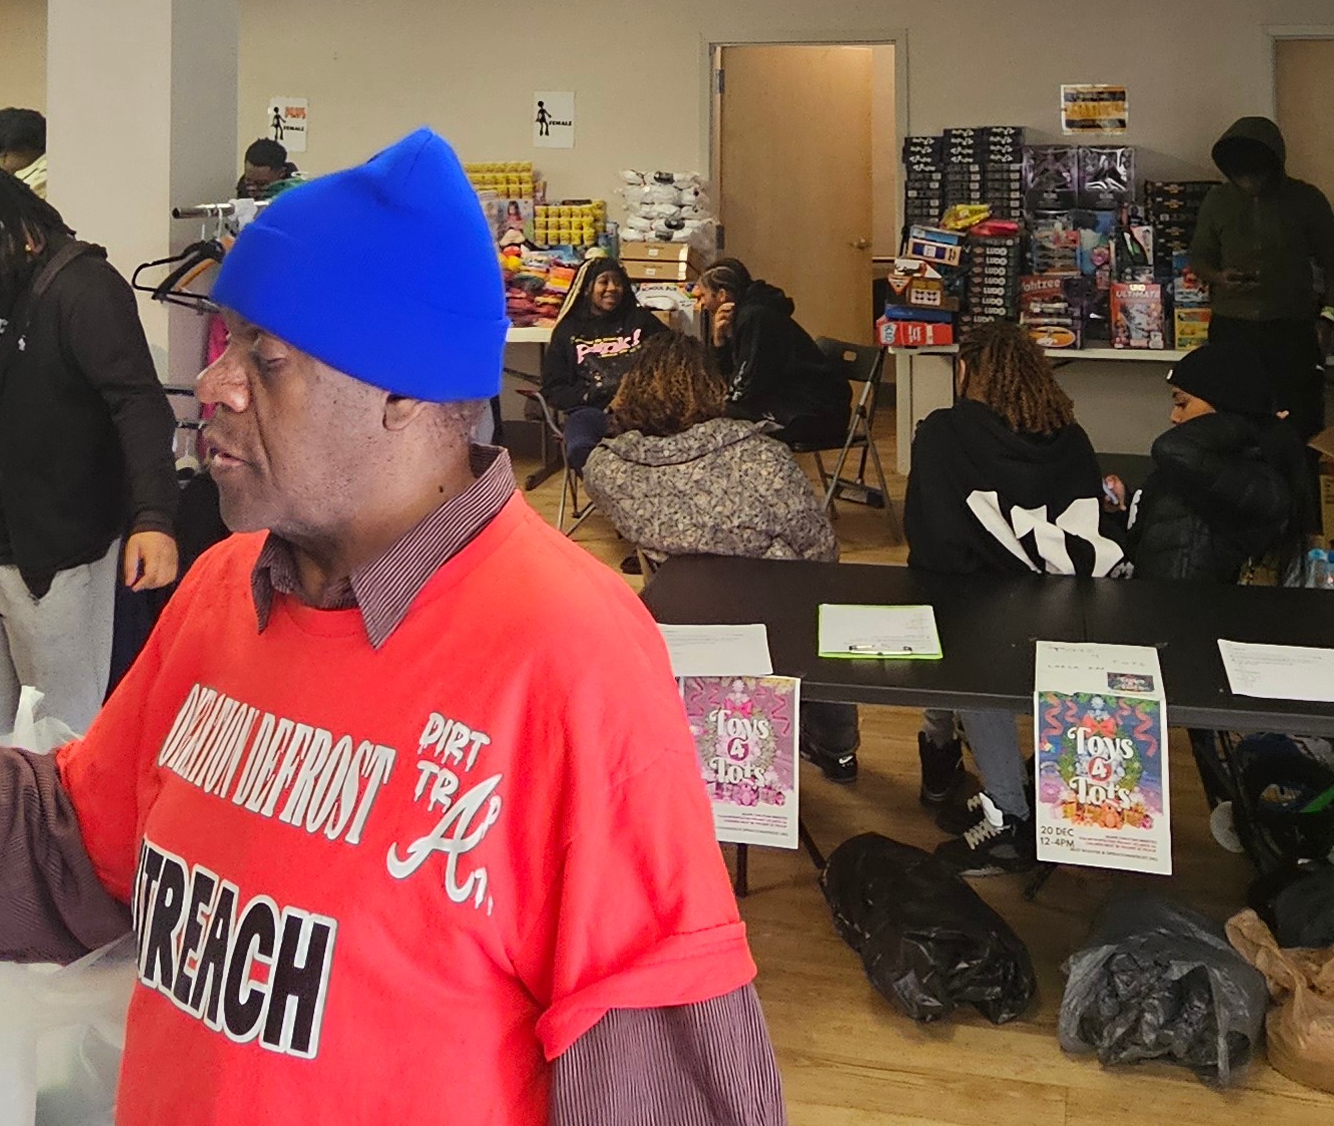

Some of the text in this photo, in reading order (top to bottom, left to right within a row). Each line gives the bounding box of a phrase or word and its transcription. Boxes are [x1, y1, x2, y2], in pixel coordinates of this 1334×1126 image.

[986, 247, 1008, 256] LUDO
[985, 257, 1008, 266] LUDO
[984, 267, 1006, 276] LUDO
[984, 277, 1006, 286] LUDO
[983, 287, 1005, 296] LUDO
[981, 296, 1004, 307] LUDO
[984, 306, 1006, 316] LUDO
[708, 709, 770, 740] Toys
[417, 711, 491, 773] DIRT
[729, 738, 746, 759] 4
[1067, 726, 1134, 764] Toys
[710, 756, 766, 788] Tots
[1092, 758, 1107, 778] 4
[231, 712, 397, 846] DEFROST
[1069, 776, 1132, 811] Tots
[1040, 825, 1075, 837] 20 DEC
[1040, 836, 1075, 848] 12-4PM
[132, 834, 339, 1060] TREACH
